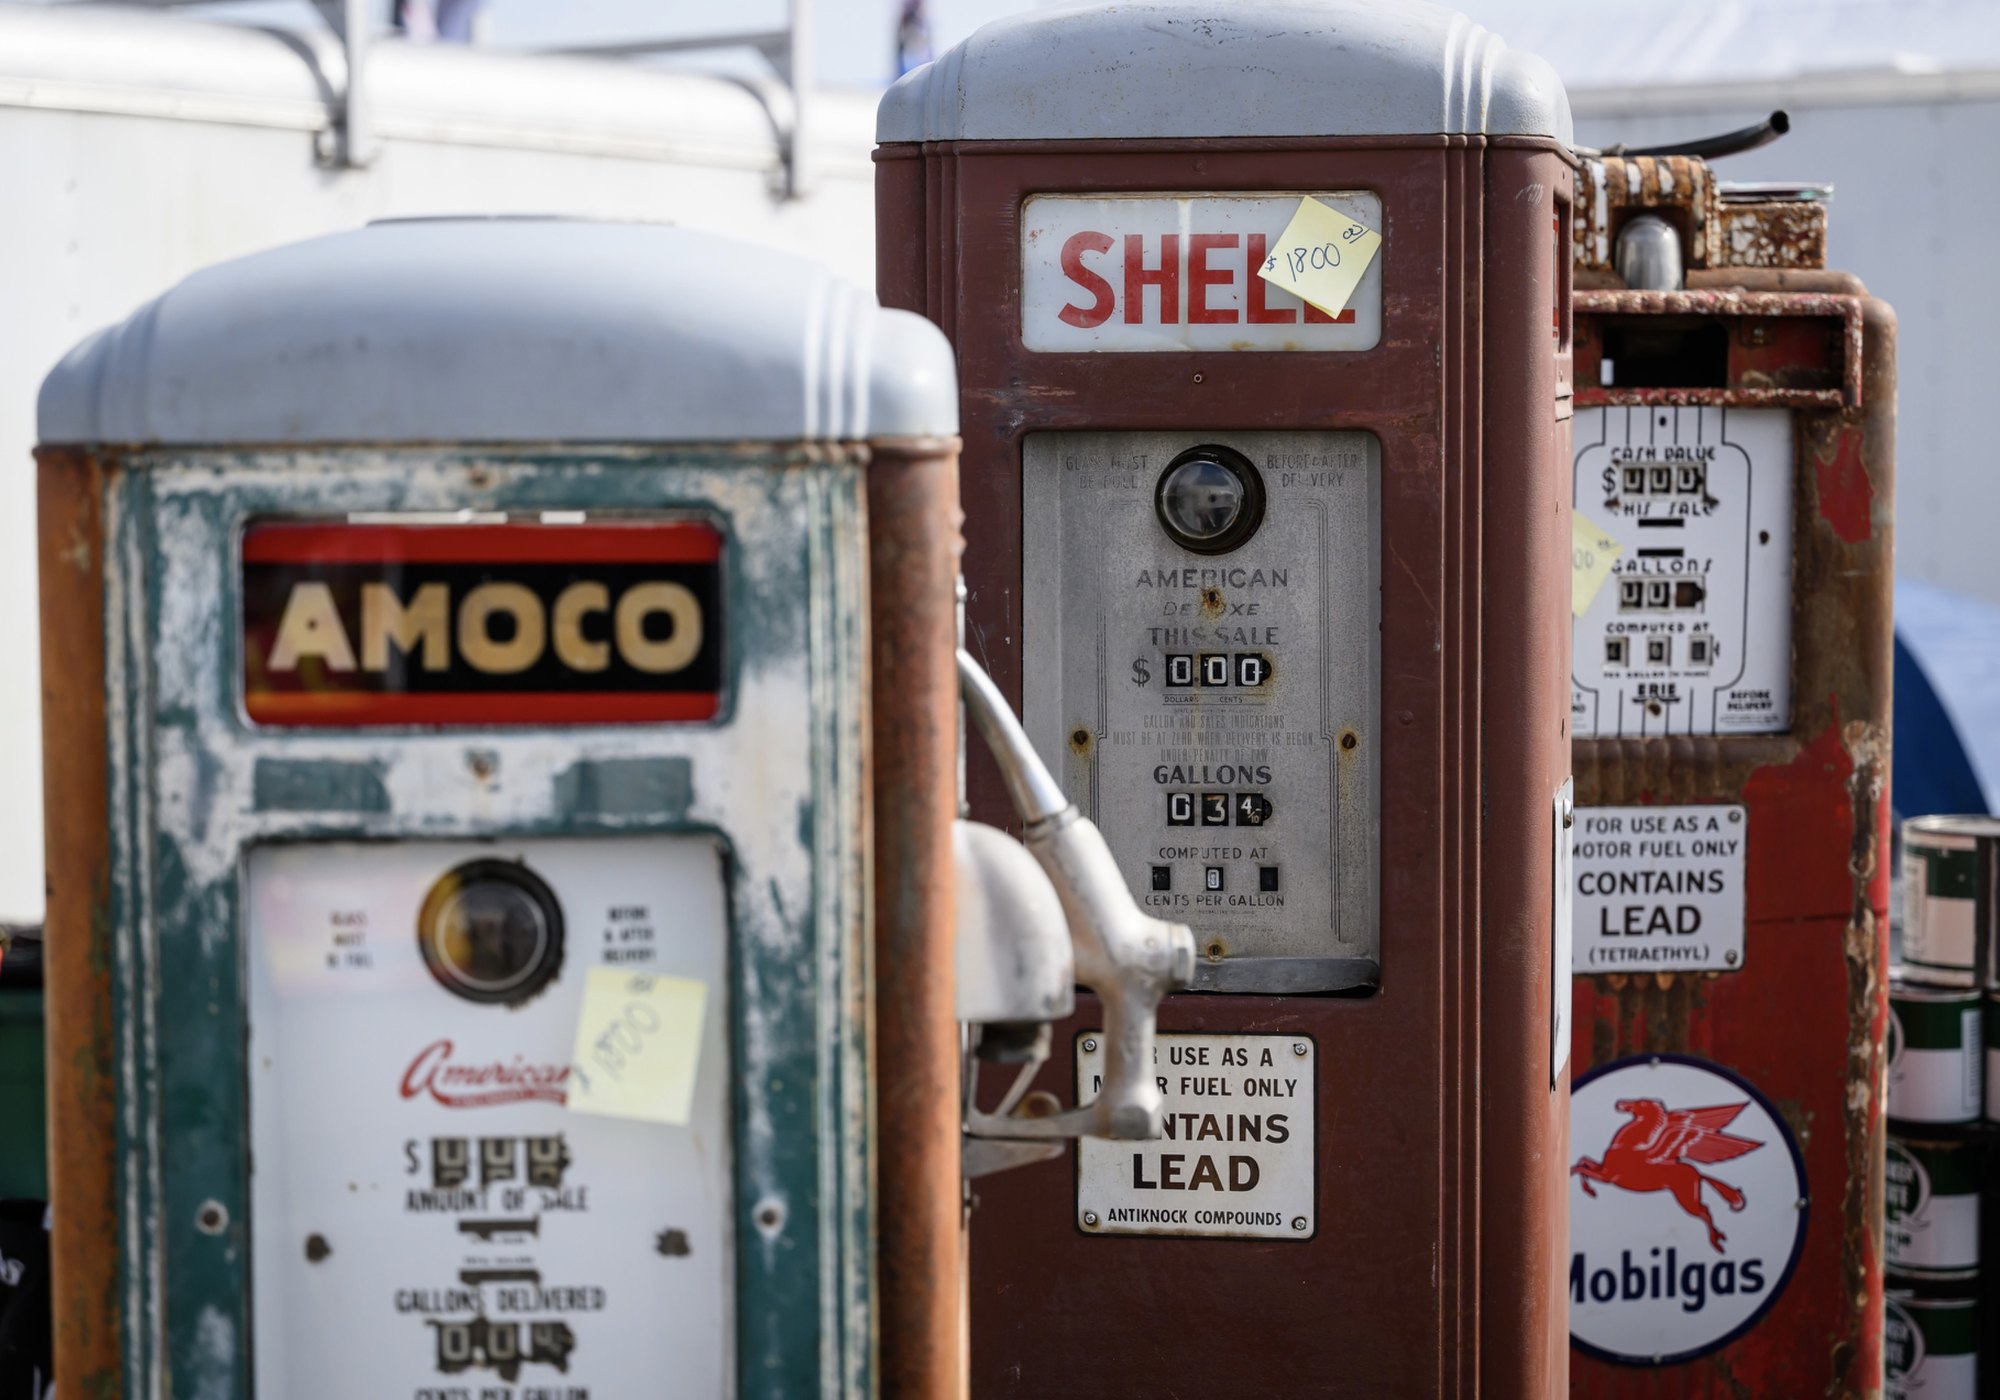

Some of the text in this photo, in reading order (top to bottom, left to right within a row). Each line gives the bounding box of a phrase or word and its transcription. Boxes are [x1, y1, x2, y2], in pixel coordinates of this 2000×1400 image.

[1058, 231, 1355, 328] SHEL
[1267, 453, 1310, 469] BEFORE
[1282, 473, 1343, 487] DEVERY
[1611, 500, 1650, 516] HIS
[1611, 559, 1712, 574] GALLONS
[1136, 568, 1288, 589] AMERICAN
[267, 581, 704, 673] AMOCO
[1146, 626, 1279, 646] THIS SALE
[1606, 622, 1710, 634] COMPUTED AT
[1131, 655, 1151, 687] $
[1637, 683, 1676, 697] ERIE
[1113, 732, 1136, 745] MUST
[1157, 732, 1166, 745] AT
[1153, 765, 1272, 785] GALLONS
[1586, 816, 1720, 834] FOR USE AS A
[1159, 847, 1268, 859] COMPUTED AT
[1639, 841, 1685, 858] FUEL
[1692, 840, 1739, 858] ONLY
[1578, 869, 1724, 896] CONTAINS
[1145, 894, 1285, 907] CENTS PER GALLON
[1600, 905, 1702, 937] LEAD
[1588, 945, 1710, 964] (TETRAETHYL)
[1170, 1047, 1209, 1065] USE
[1222, 1047, 1248, 1066] AS
[1260, 1048, 1273, 1067] A
[1181, 1077, 1232, 1096] FUEL
[1244, 1078, 1297, 1097] ONLY
[1161, 1113, 1290, 1144] NTAINS
[1133, 1153, 1260, 1191] LEAD
[406, 1187, 488, 1212] AMOUNT
[502, 1187, 524, 1211] OF
[1108, 1208, 1282, 1226] ANTIKNOCK COMPOUNDS
[394, 1286, 607, 1313] GALLONS DELIVERED
